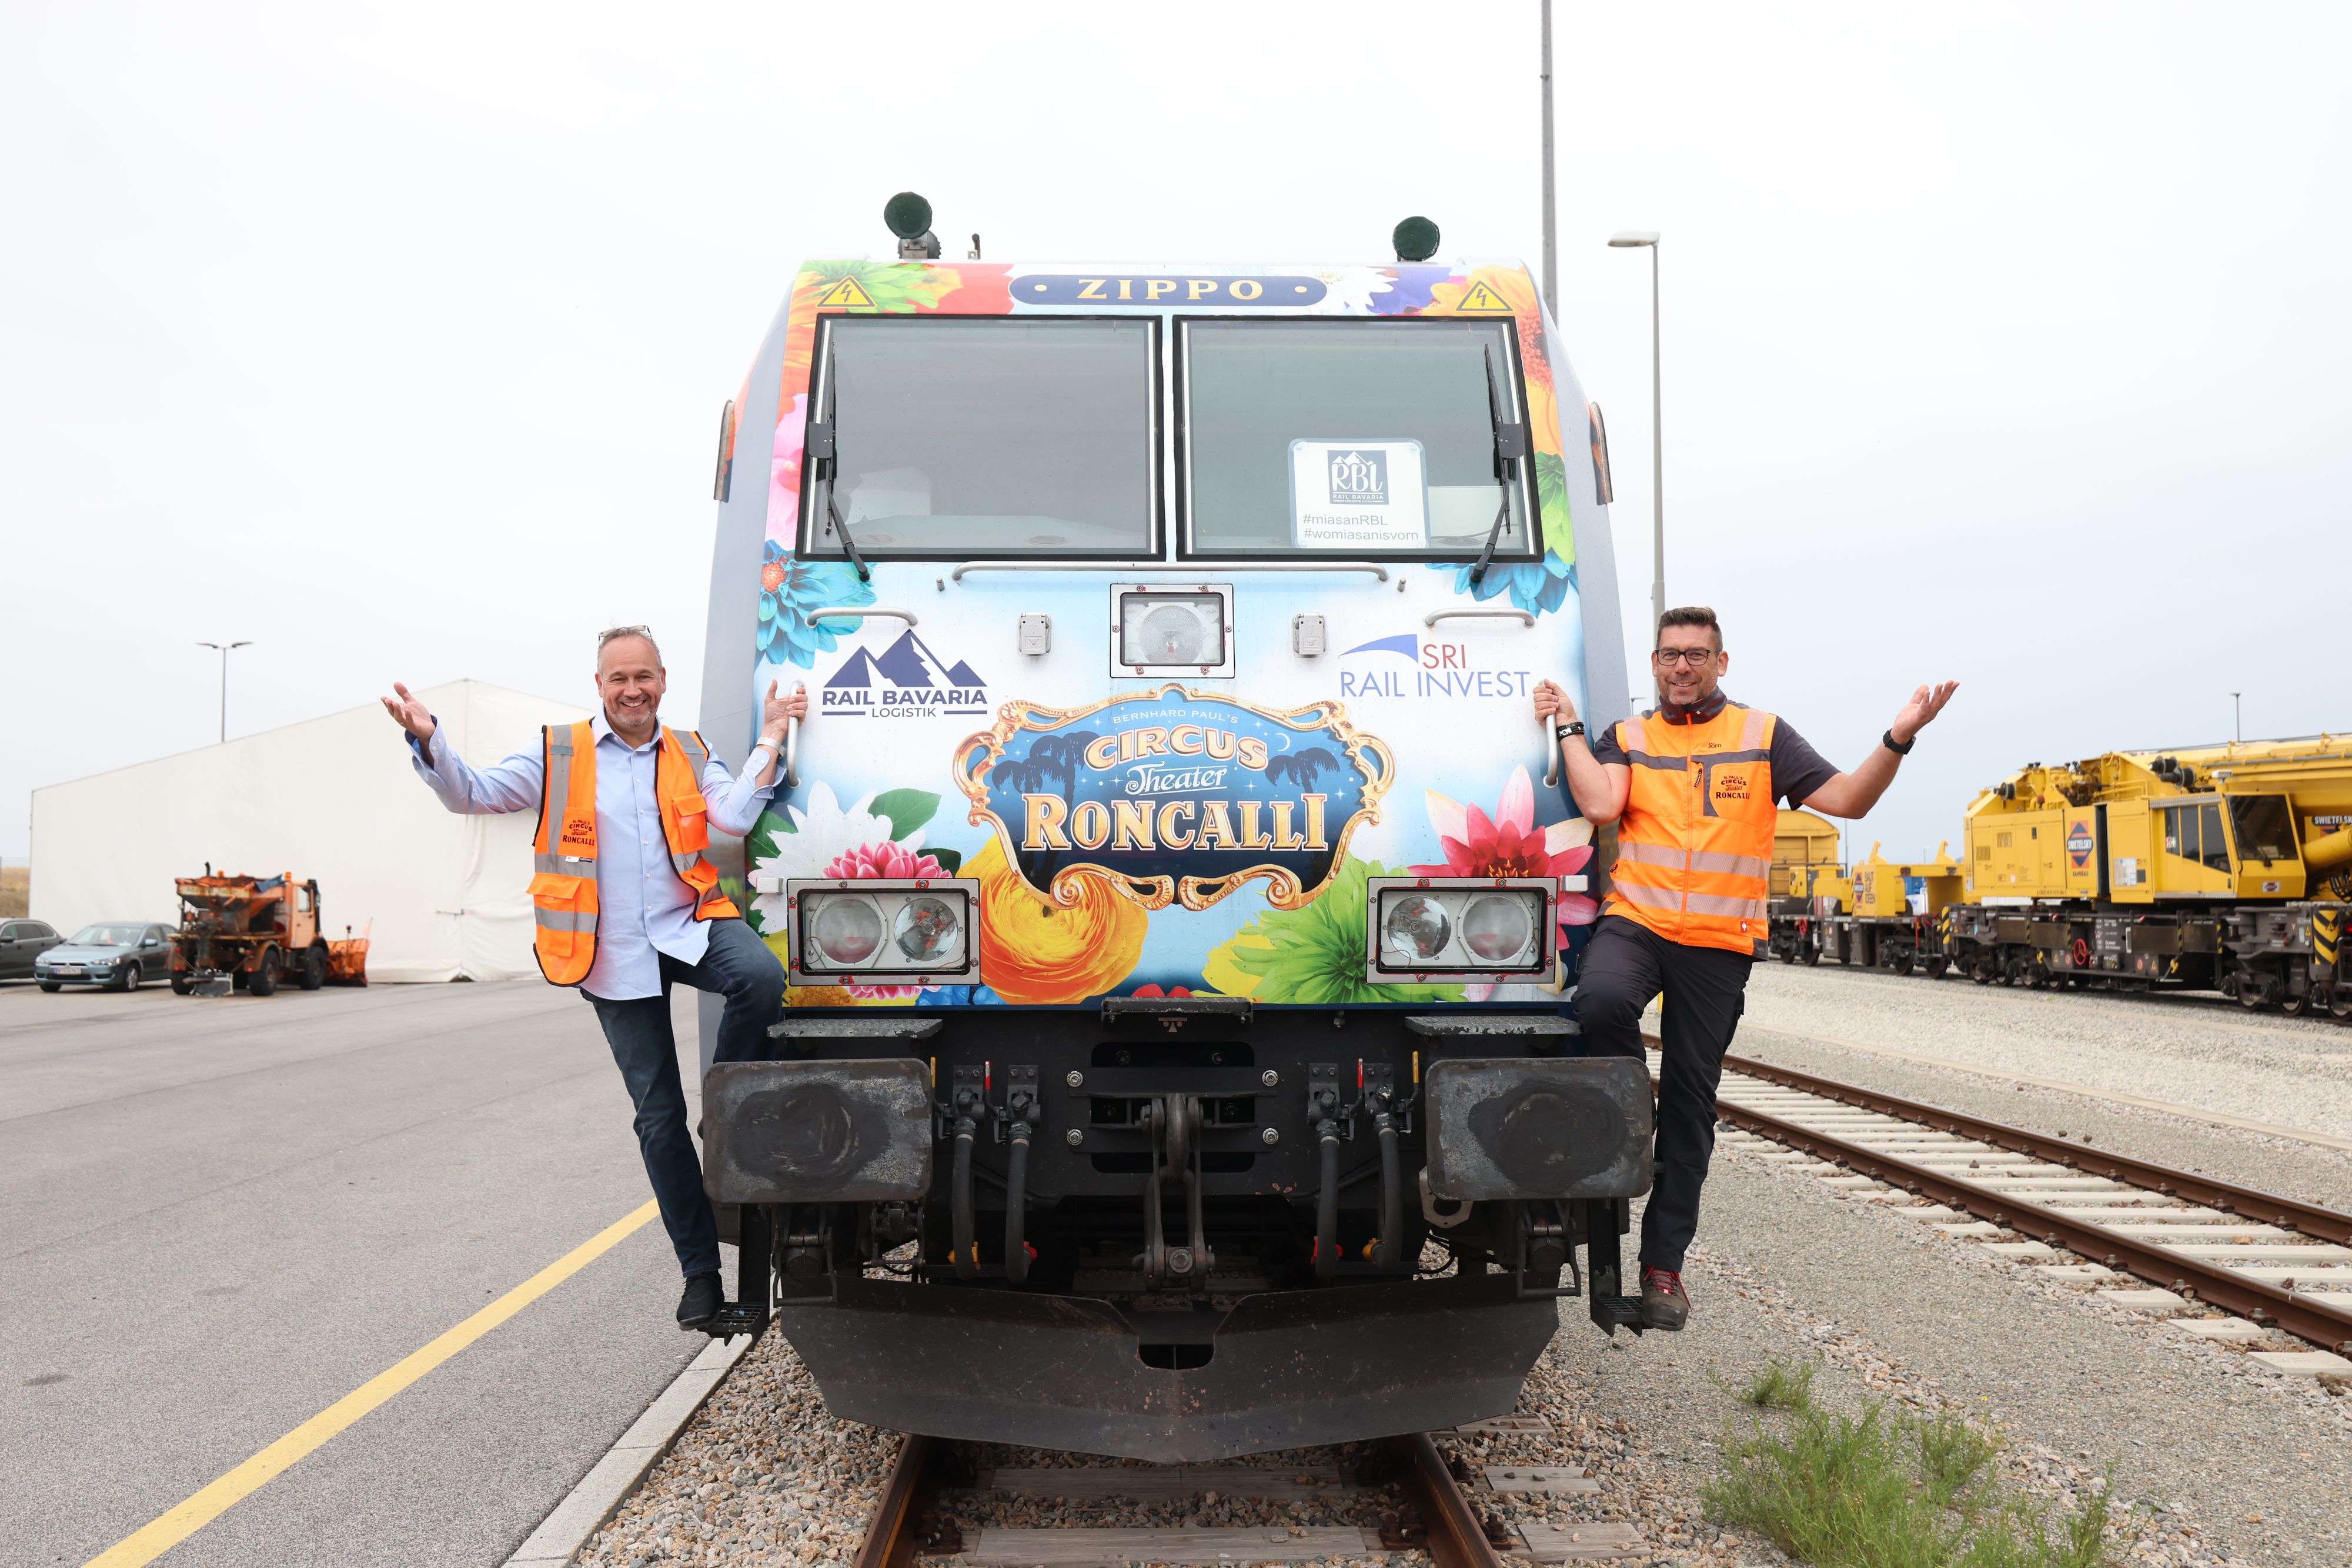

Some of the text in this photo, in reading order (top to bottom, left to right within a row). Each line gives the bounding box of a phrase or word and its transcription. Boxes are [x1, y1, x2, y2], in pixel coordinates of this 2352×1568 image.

[1077, 279, 1264, 301] ZIPPO
[1331, 463, 1383, 492] RBL
[1302, 513, 1388, 526] #miasanRBL
[1304, 528, 1419, 540] #womiasanisvorn
[1422, 644, 1466, 669] SRI
[1341, 671, 1530, 697] RAIL INVEST
[822, 690, 987, 705] RAIL BAVARIA
[871, 707, 937, 718] LOGISTIK
[1113, 709, 1238, 724] BERNHARD PAUL'S
[1085, 724, 1269, 771] CIRCUS
[1125, 761, 1228, 796] Theater
[1021, 793, 1329, 851] RONCALLI
[563, 835, 594, 845] RONCALLI
[2067, 839, 2092, 850] SWIETELSKY
